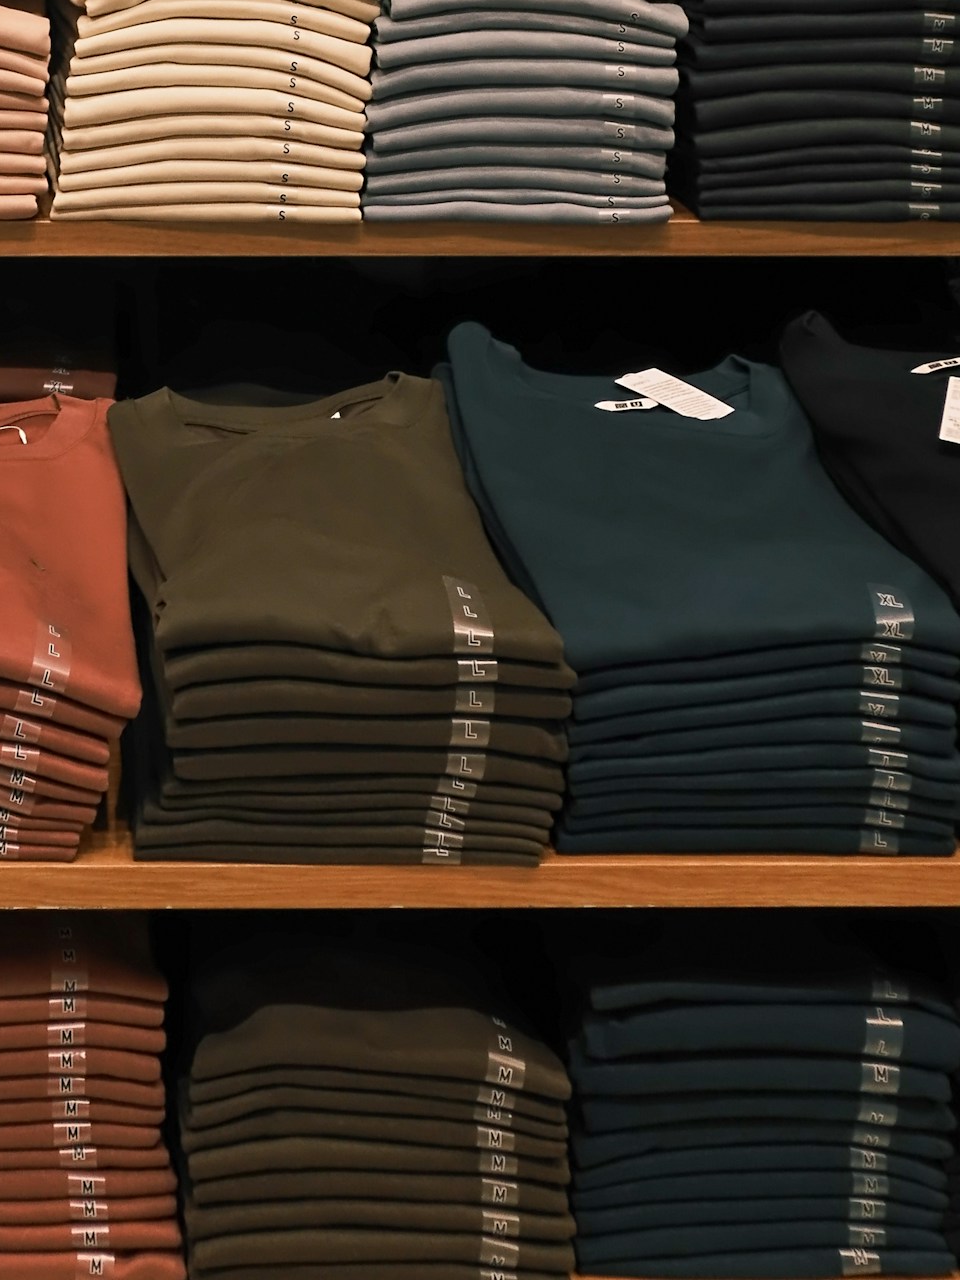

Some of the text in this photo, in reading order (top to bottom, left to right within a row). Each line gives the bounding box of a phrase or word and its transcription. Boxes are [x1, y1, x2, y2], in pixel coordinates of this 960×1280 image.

[294, 31, 300, 40] S
[618, 42, 624, 52] S
[618, 67, 624, 77] S
[925, 69, 935, 82] M
[289, 78, 296, 88] S
[288, 102, 294, 112] S
[616, 98, 623, 108] S
[617, 128, 623, 138] S
[283, 144, 290, 154] S
[279, 211, 285, 220] S
[612, 213, 618, 222] S
[457, 586, 471, 599] L
[876, 593, 903, 608] XL
[462, 605, 477, 618] L
[49, 625, 61, 637] L
[882, 620, 904, 638] XL
[467, 629, 480, 646] L
[48, 643, 60, 657] L
[42, 669, 54, 687] L
[872, 667, 895, 685] XL
[31, 688, 43, 705] L
[470, 691, 481, 707] L
[465, 721, 476, 739] L
[460, 756, 471, 773] L
[875, 832, 887, 847] L
[61, 1029, 73, 1044] M
[499, 1068, 512, 1083] M
[874, 1066, 888, 1082] M
[65, 1102, 77, 1116] M
[67, 1126, 79, 1141] M
[493, 1156, 505, 1172] M
[82, 1180, 94, 1194] M
[494, 1187, 507, 1202] M
[90, 1260, 102, 1275] M
